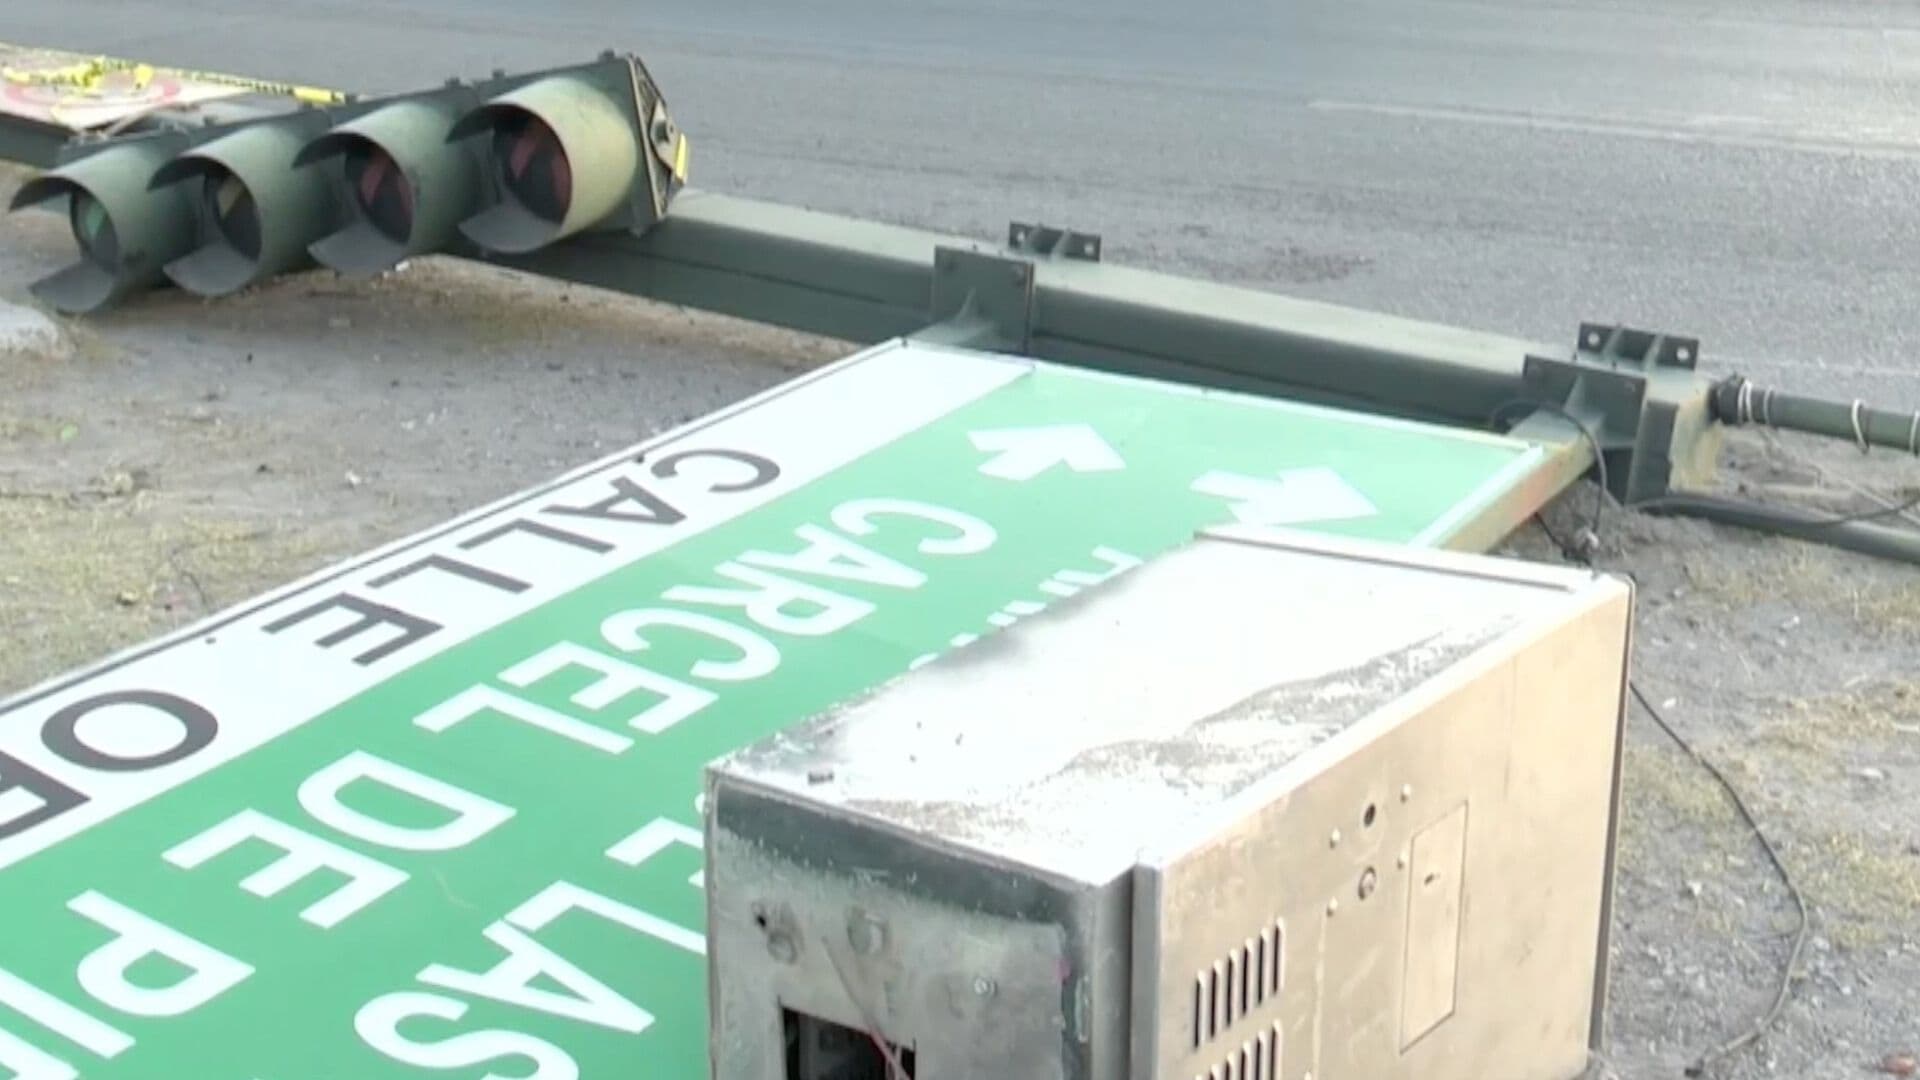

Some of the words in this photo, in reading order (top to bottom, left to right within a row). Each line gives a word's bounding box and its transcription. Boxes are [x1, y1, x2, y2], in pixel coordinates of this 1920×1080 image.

[261, 448, 781, 665] CALLE
[411, 498, 998, 755] CARCEL
[161, 750, 517, 929] DE
[0, 890, 256, 1080] PI
[354, 880, 707, 1080] LAS
